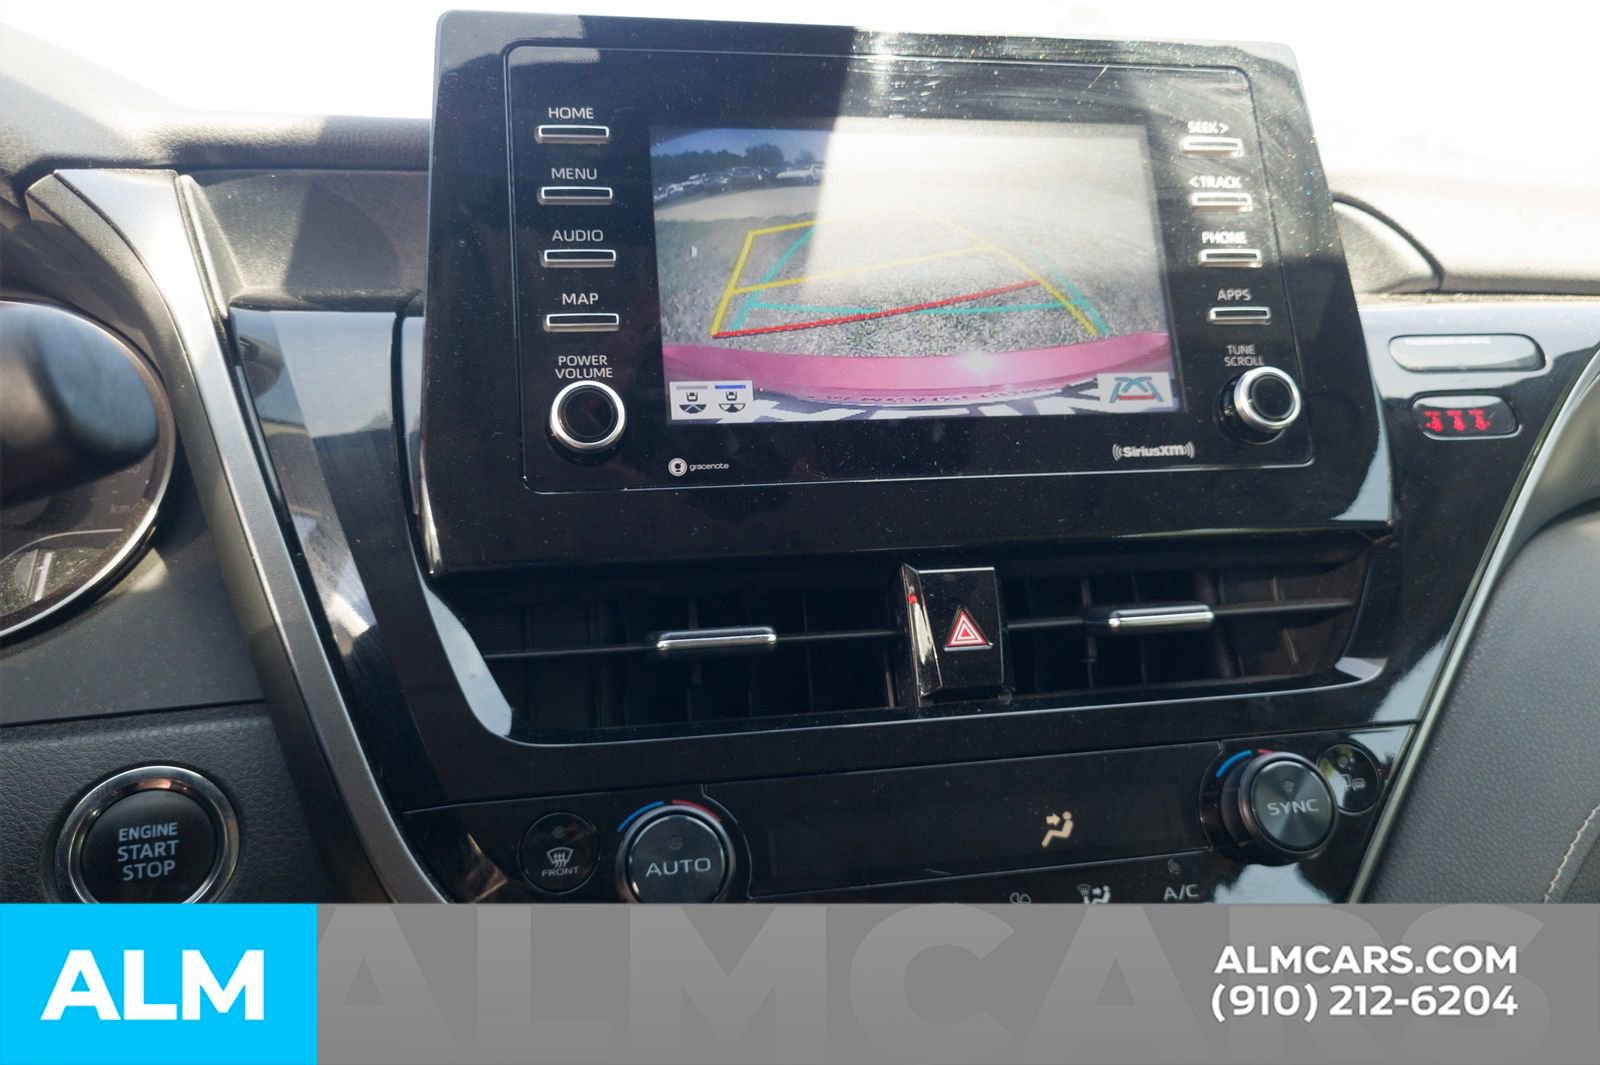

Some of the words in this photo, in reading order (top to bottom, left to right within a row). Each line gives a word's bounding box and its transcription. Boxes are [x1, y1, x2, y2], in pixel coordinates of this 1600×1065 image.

[548, 107, 595, 119] HOME
[551, 167, 598, 180] MENU
[552, 229, 604, 242] AUDIO
[1202, 231, 1248, 244] PHONE
[562, 293, 599, 305] MAP
[1217, 289, 1252, 302] APPS
[1226, 344, 1256, 355] TUNE
[558, 355, 608, 366] POWER
[1224, 356, 1265, 367] SCROLL
[555, 367, 613, 379] VOLUME
[689, 463, 729, 471] gracenote
[1266, 798, 1320, 817] SYNC
[118, 822, 179, 843] ENGINE
[117, 840, 179, 863] START
[122, 860, 176, 882] STOP
[541, 866, 580, 877] FRONT
[645, 857, 712, 878] AUTO
[1164, 884, 1200, 901] A/C
